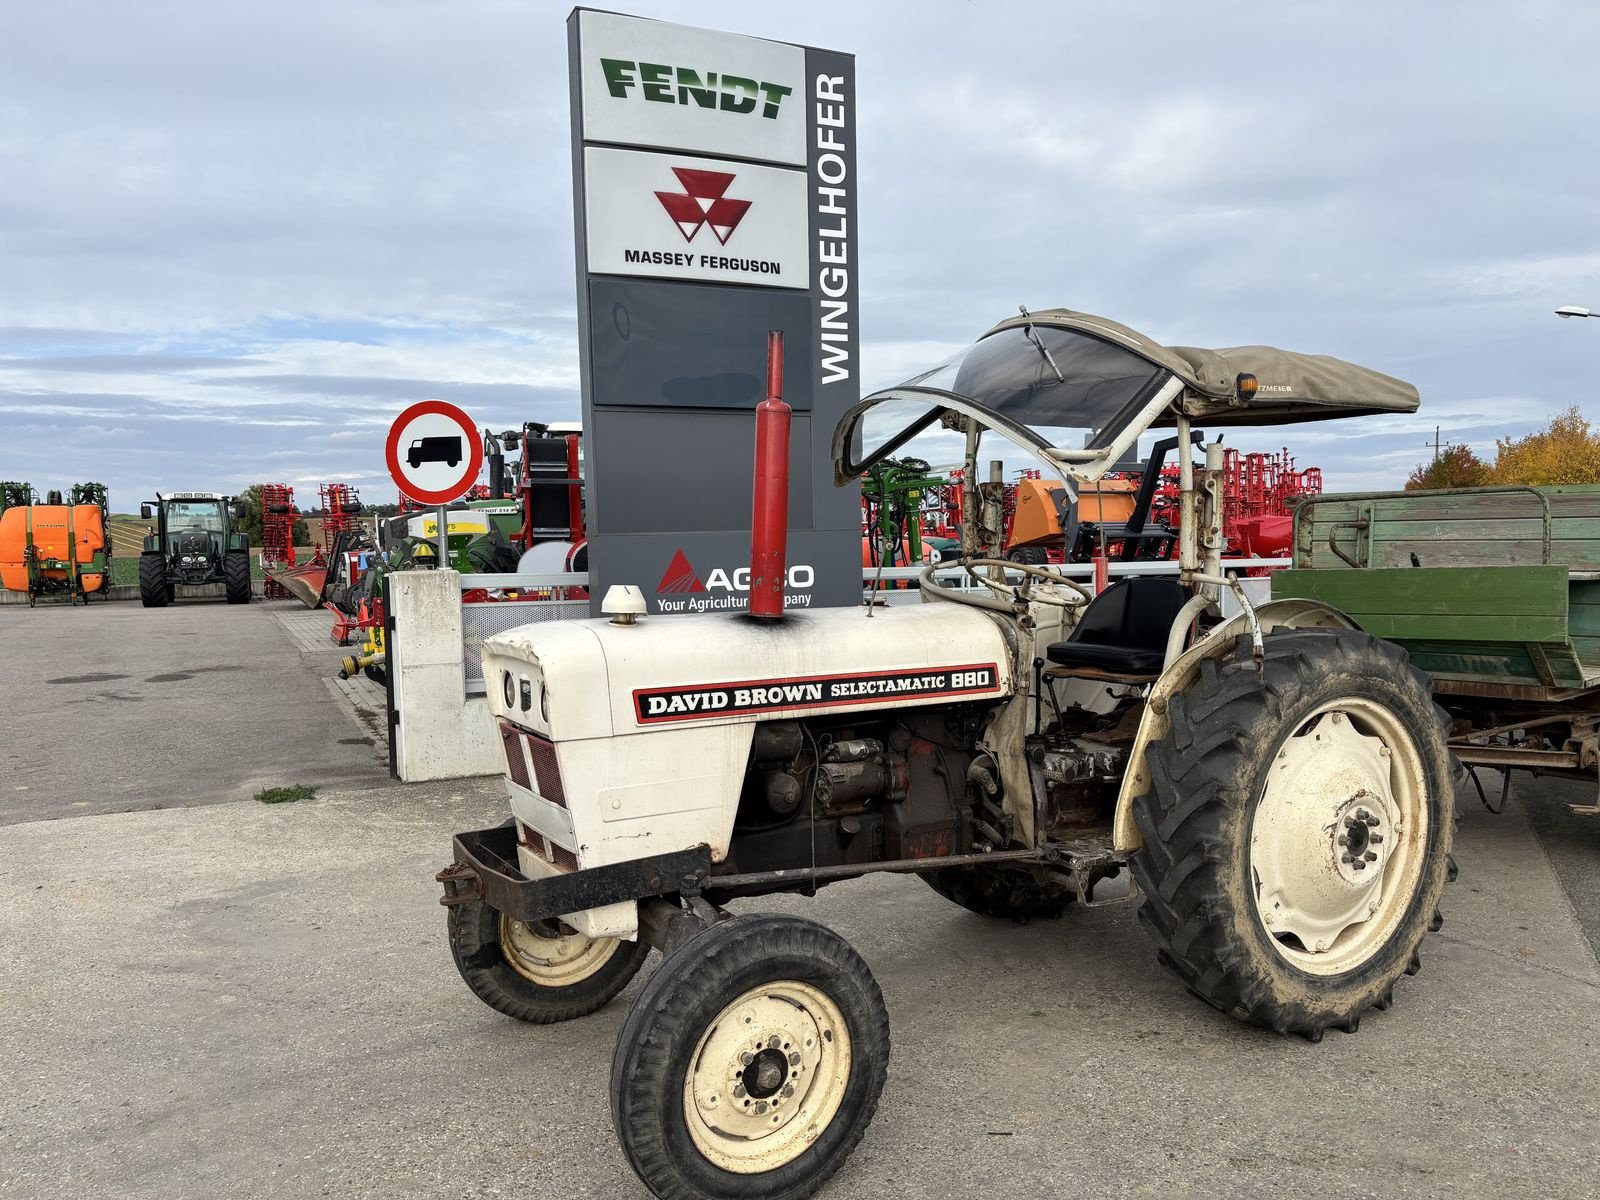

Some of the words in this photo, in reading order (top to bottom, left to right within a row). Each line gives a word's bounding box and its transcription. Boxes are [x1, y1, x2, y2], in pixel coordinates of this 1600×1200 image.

[600, 58, 793, 120] FENDT
[816, 73, 850, 385] WINGELHOFER
[624, 249, 694, 266] MASSEY
[700, 255, 781, 275] FERGUSON
[705, 565, 815, 592] AGO
[657, 599, 686, 612] Your
[688, 595, 748, 613] Agricultur
[784, 594, 812, 608] pany
[648, 691, 729, 715] DAVID
[734, 683, 822, 707] BROWN
[830, 675, 946, 697] SELECTAMATIC
[951, 670, 990, 689] 880
